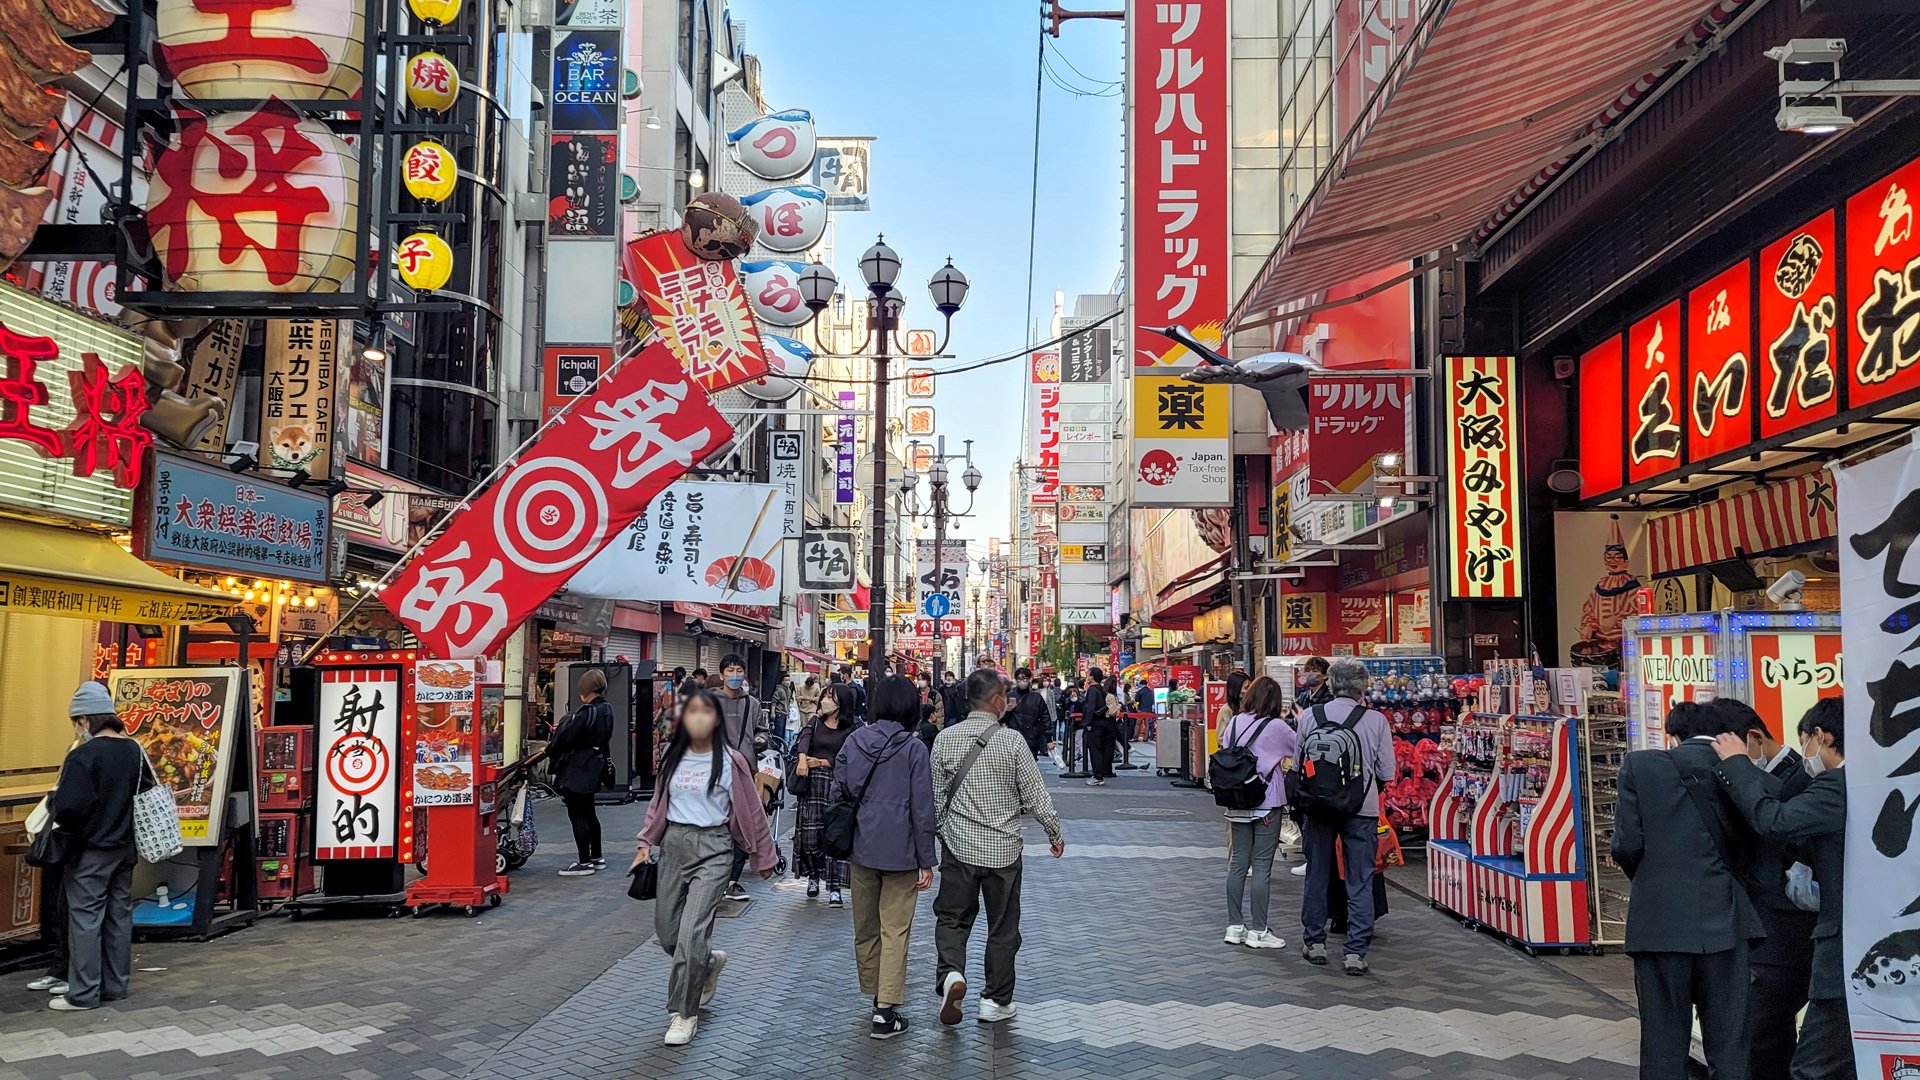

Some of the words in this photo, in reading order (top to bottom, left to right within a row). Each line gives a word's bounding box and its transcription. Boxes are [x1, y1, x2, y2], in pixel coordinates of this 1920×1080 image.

[568, 69, 604, 81] BAR
[555, 92, 616, 103] OCEAN
[1155, 4, 1207, 320] ツルハドラッグ
[821, 162, 863, 193] 牛角
[659, 273, 713, 377] ミュージアム
[0, 321, 153, 489] 王将
[267, 370, 284, 419] 大阪店
[1158, 384, 1205, 430] 薬
[1314, 383, 1401, 410] ツルハ
[315, 398, 329, 443] CAFE
[1314, 416, 1385, 435] ドラッグ
[777, 439, 797, 454] 牛角
[1040, 386, 1059, 494] ジャンカラ
[1066, 433, 1101, 441] レインボー
[838, 423, 854, 491] 元禄寿司
[1188, 463, 1227, 474] Tax-free
[1191, 452, 1226, 463] Japan.
[1201, 474, 1226, 485] Shop
[1457, 371, 1511, 583] 大阪みやげ
[155, 470, 172, 541] 景品付
[236, 485, 266, 504] 日本一
[172, 494, 313, 552] 大衆娯楽遊戯場
[338, 508, 353, 519] GAME
[353, 511, 370, 523] HOUSE
[1275, 492, 1289, 557] 薬
[313, 509, 325, 566] 景品付
[806, 543, 850, 577] 牛角
[920, 568, 960, 590] くら
[12, 584, 123, 616] 創業昭和四十四年
[136, 600, 184, 620] 元祖餃子
[1068, 611, 1097, 619] ZAZA
[1286, 597, 1312, 629] 薬
[1341, 597, 1376, 609] ツルハ
[1341, 610, 1369, 618] ドラッグ
[1643, 655, 1715, 684] WELCOME
[143, 680, 212, 703] 始まりの
[416, 690, 474, 701] かにつめ道楽
[116, 701, 222, 736] 肉チャーハン
[331, 740, 383, 760] 大当り
[332, 684, 385, 845] 射的
[414, 793, 472, 804] かにつめ道楽
